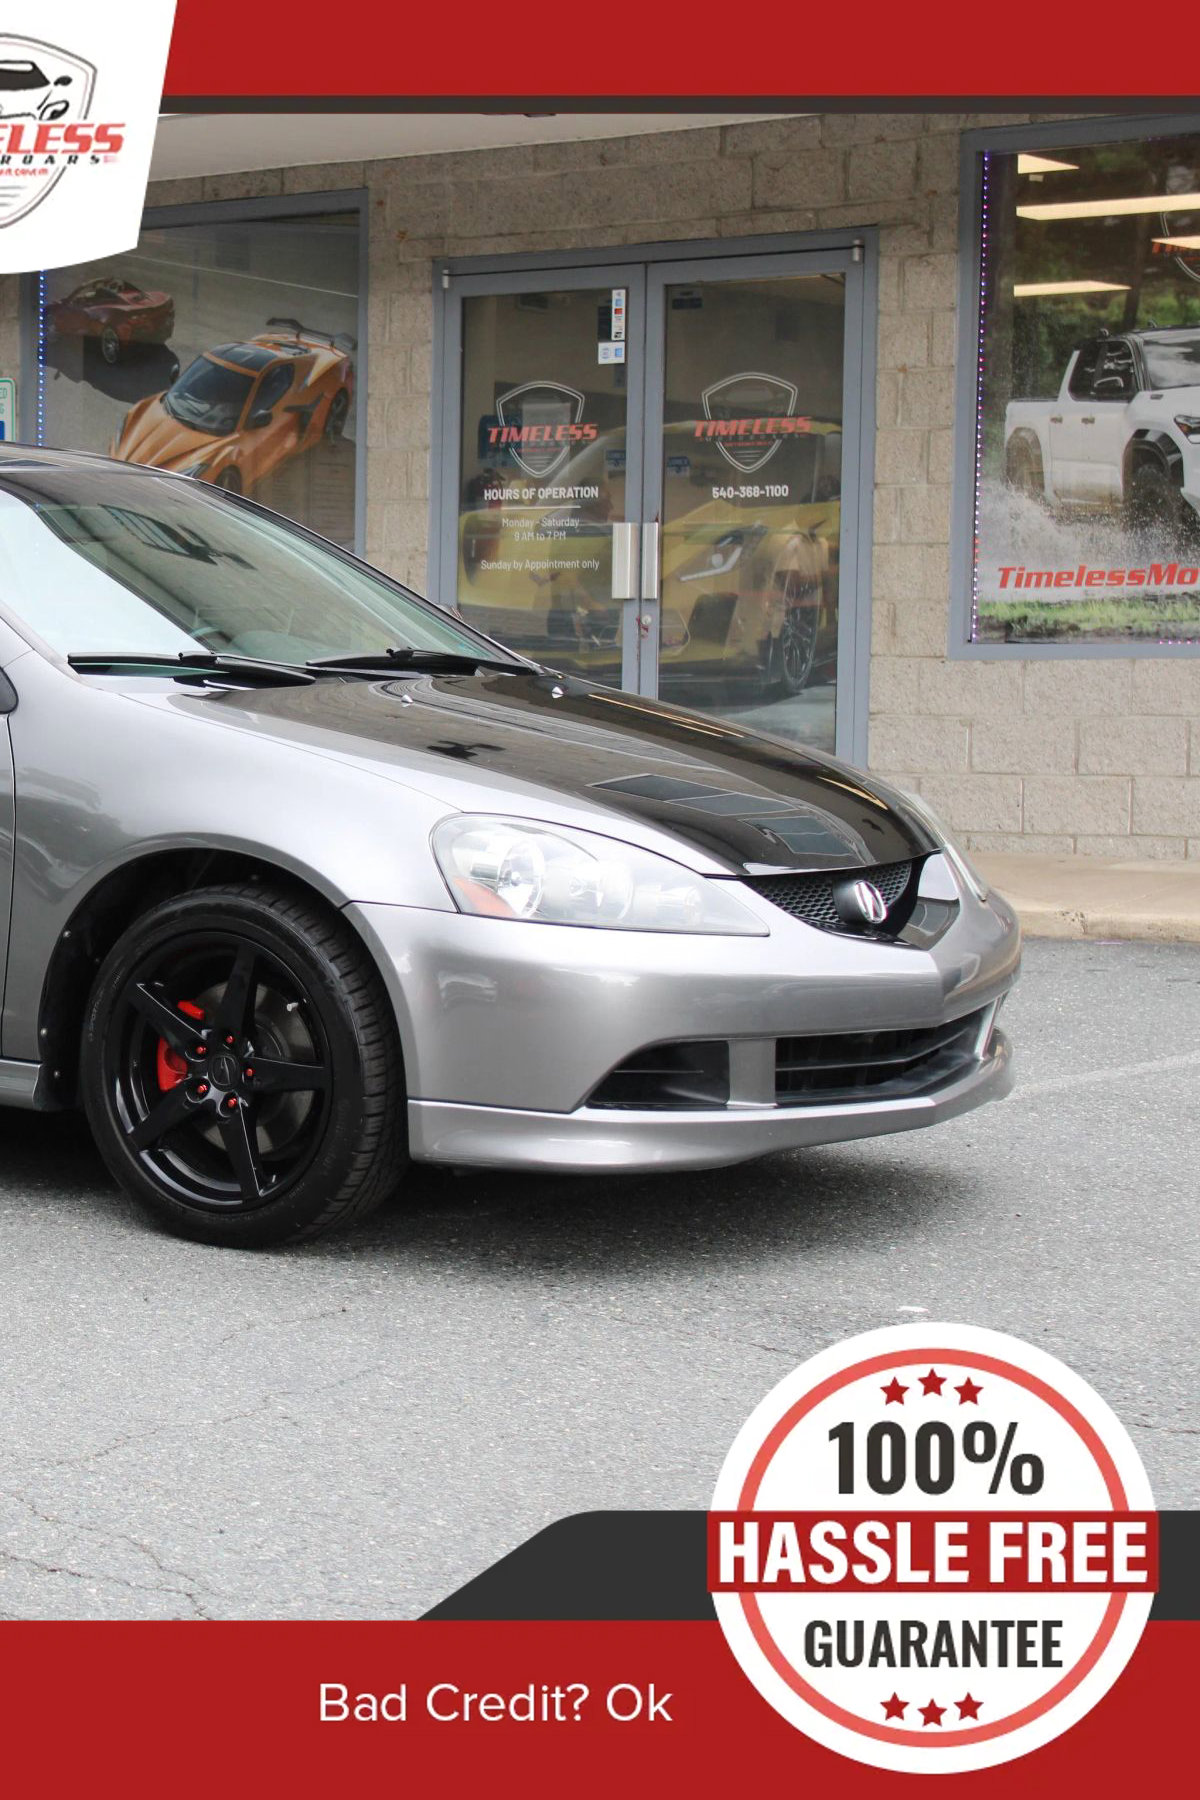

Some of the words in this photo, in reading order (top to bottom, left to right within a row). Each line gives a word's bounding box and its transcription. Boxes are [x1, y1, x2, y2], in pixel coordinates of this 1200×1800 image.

[488, 424, 598, 443] TIMELESS
[695, 417, 812, 437] TIMELESS
[484, 488, 520, 501] HOURS
[521, 487, 536, 500] OF
[537, 486, 599, 500] OPERATION
[712, 485, 789, 498] 540-368-1100
[502, 518, 534, 529] Monday
[541, 517, 580, 528] Saturday
[514, 532, 520, 542] 9
[521, 531, 535, 541] AM
[536, 531, 545, 541] to
[553, 530, 567, 540] PM
[481, 559, 511, 571] Sunday
[513, 559, 523, 571] by
[525, 558, 580, 571] Appointment
[581, 558, 600, 570] only
